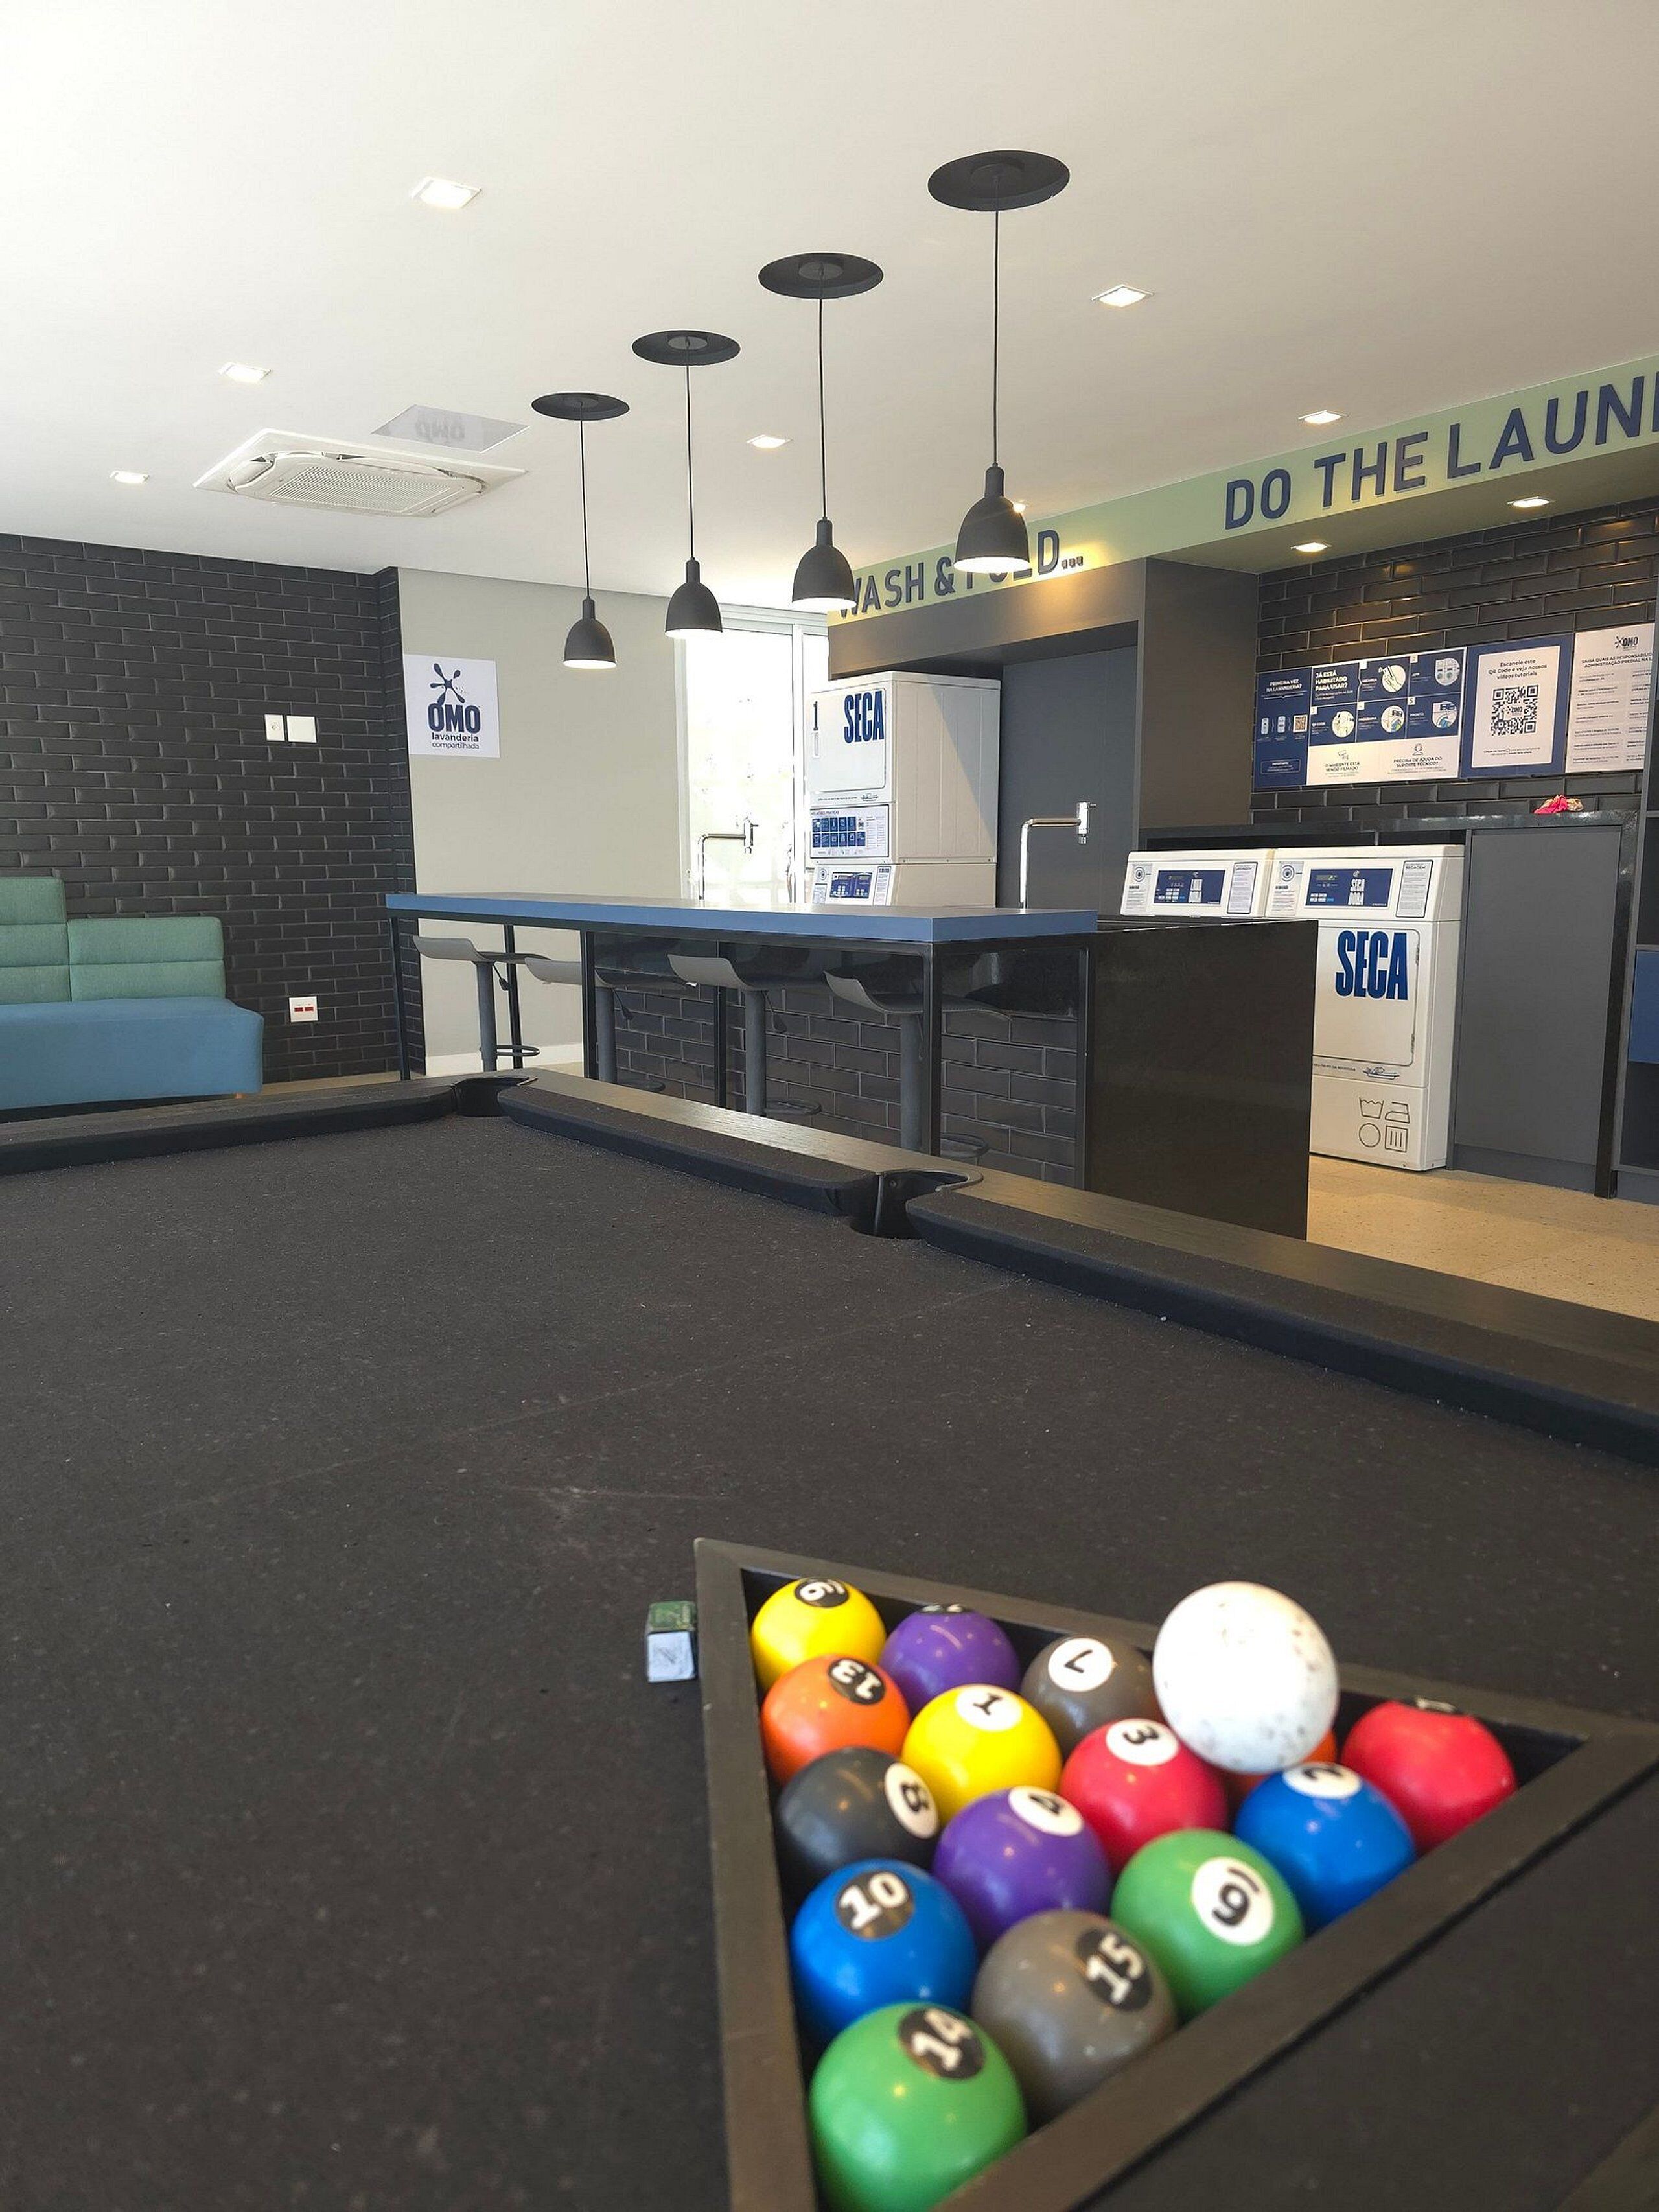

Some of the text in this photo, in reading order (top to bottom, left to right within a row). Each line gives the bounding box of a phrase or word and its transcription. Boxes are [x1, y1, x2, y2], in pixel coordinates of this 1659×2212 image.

[1225, 468, 1292, 530] DO
[1314, 432, 1428, 509] THE
[934, 556, 956, 596] &
[1622, 637, 1638, 646] OMO
[428, 703, 481, 734] OMO
[844, 690, 885, 743] SECA
[432, 732, 479, 742] lavanderia
[432, 741, 480, 750] compartilhada
[1335, 930, 1408, 1001] SECA
[832, 1660, 884, 1701] 13
[1064, 1649, 1093, 1673] 7
[973, 1693, 1002, 1716] 1
[1124, 1725, 1158, 1745] 3
[839, 1871, 908, 1929] 10
[1087, 1933, 1143, 2004] 15
[912, 2008, 971, 2071] 14
